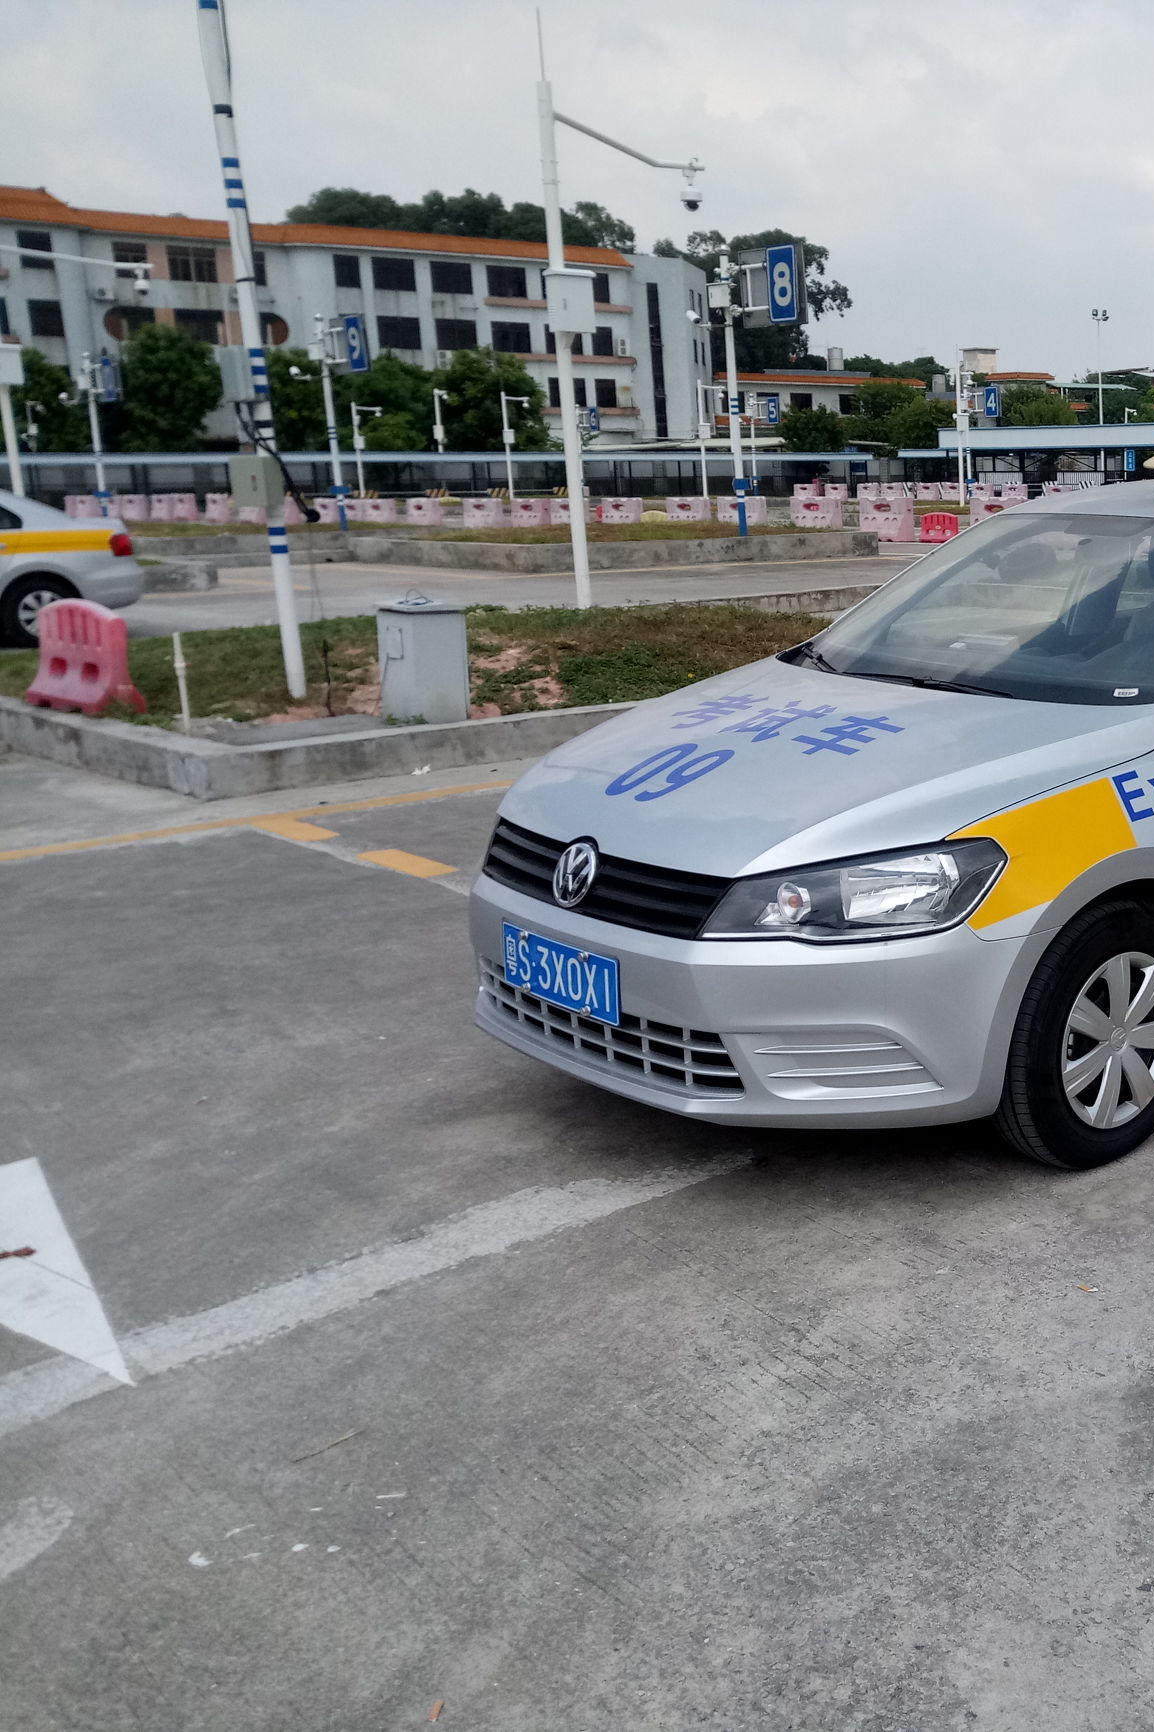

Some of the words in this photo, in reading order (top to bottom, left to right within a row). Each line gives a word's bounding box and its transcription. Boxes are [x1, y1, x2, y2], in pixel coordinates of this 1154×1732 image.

[772, 261, 793, 307] 8
[347, 326, 361, 360] 9
[590, 412, 597, 426] 6
[768, 402, 777, 419] 5
[986, 392, 997, 412] 4
[671, 694, 905, 756] 考试车
[605, 743, 736, 802] 09
